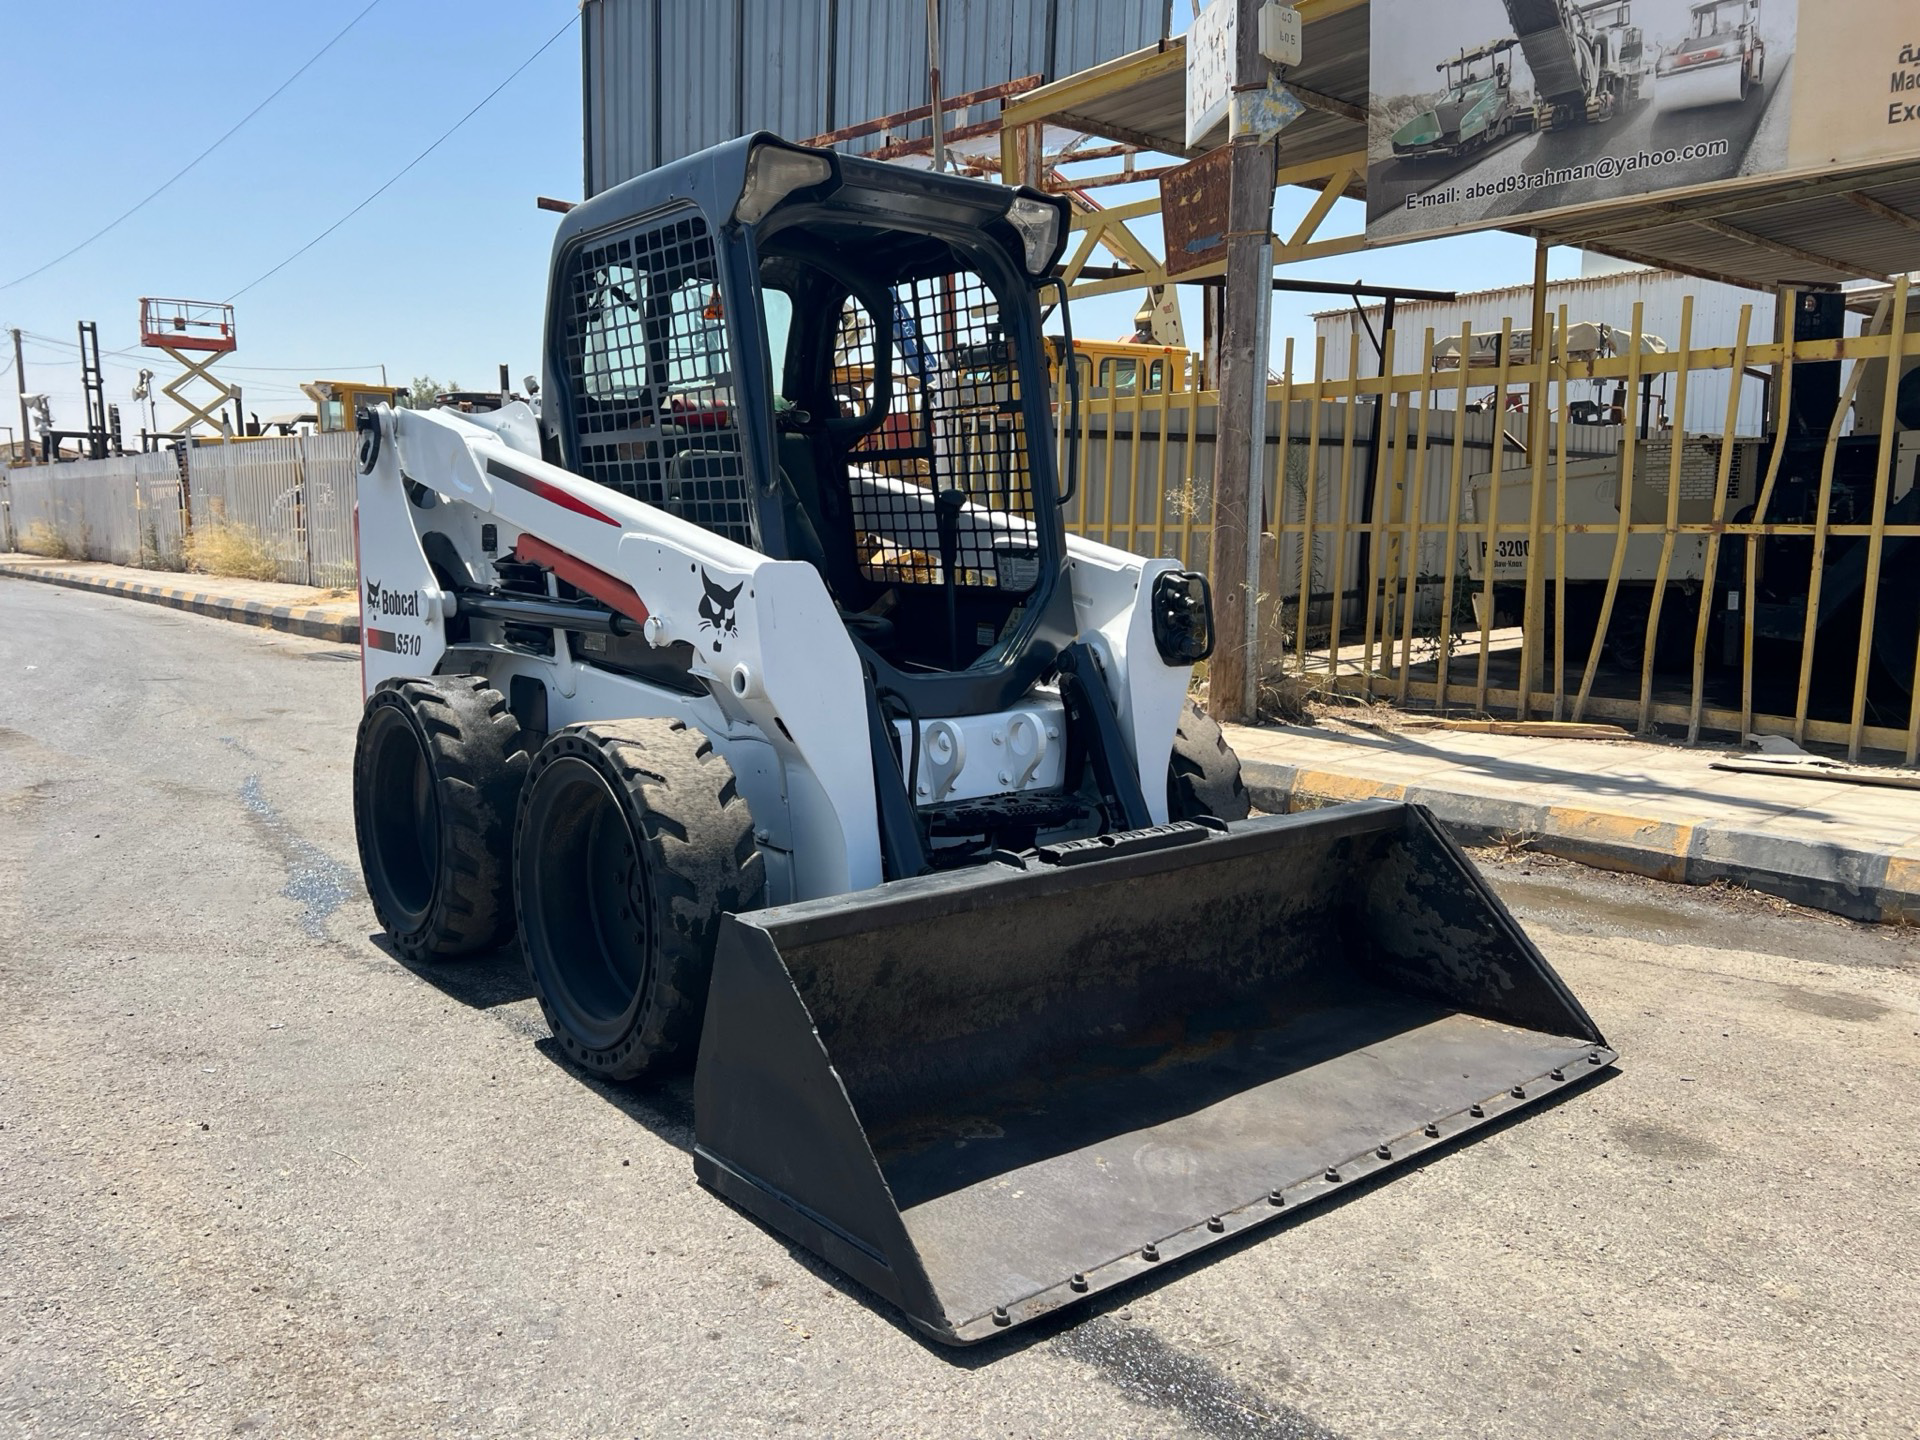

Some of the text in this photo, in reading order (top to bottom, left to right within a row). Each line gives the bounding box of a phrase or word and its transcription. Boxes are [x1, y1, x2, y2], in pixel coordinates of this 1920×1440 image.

[1406, 138, 1729, 210] E-mail: abed93rahman@yahoo.com
[1481, 540, 1530, 558] P-3200
[382, 589, 419, 617] Bobcat
[396, 633, 421, 657] S510
